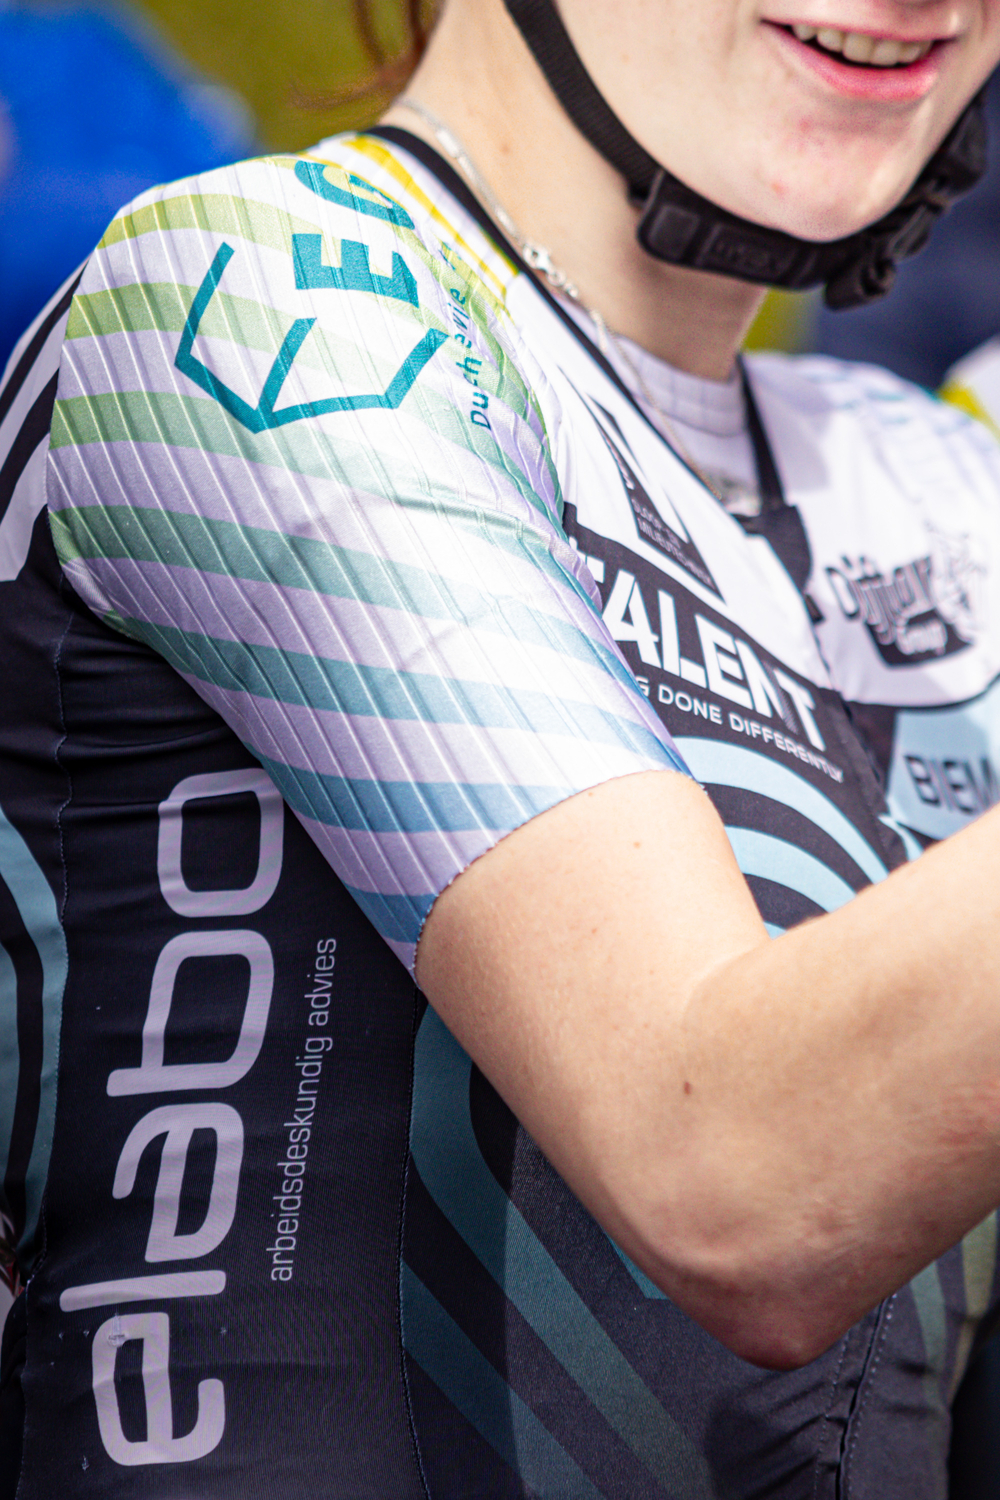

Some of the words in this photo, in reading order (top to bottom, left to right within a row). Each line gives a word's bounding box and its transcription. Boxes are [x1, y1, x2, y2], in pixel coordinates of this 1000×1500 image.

[657, 683, 723, 725] DONE
[728, 711, 845, 784] DIFFERENTLY
[59, 767, 285, 1467] elabo
[266, 1037, 333, 1282] arbeidsdeskundig
[304, 937, 337, 1027] advies
